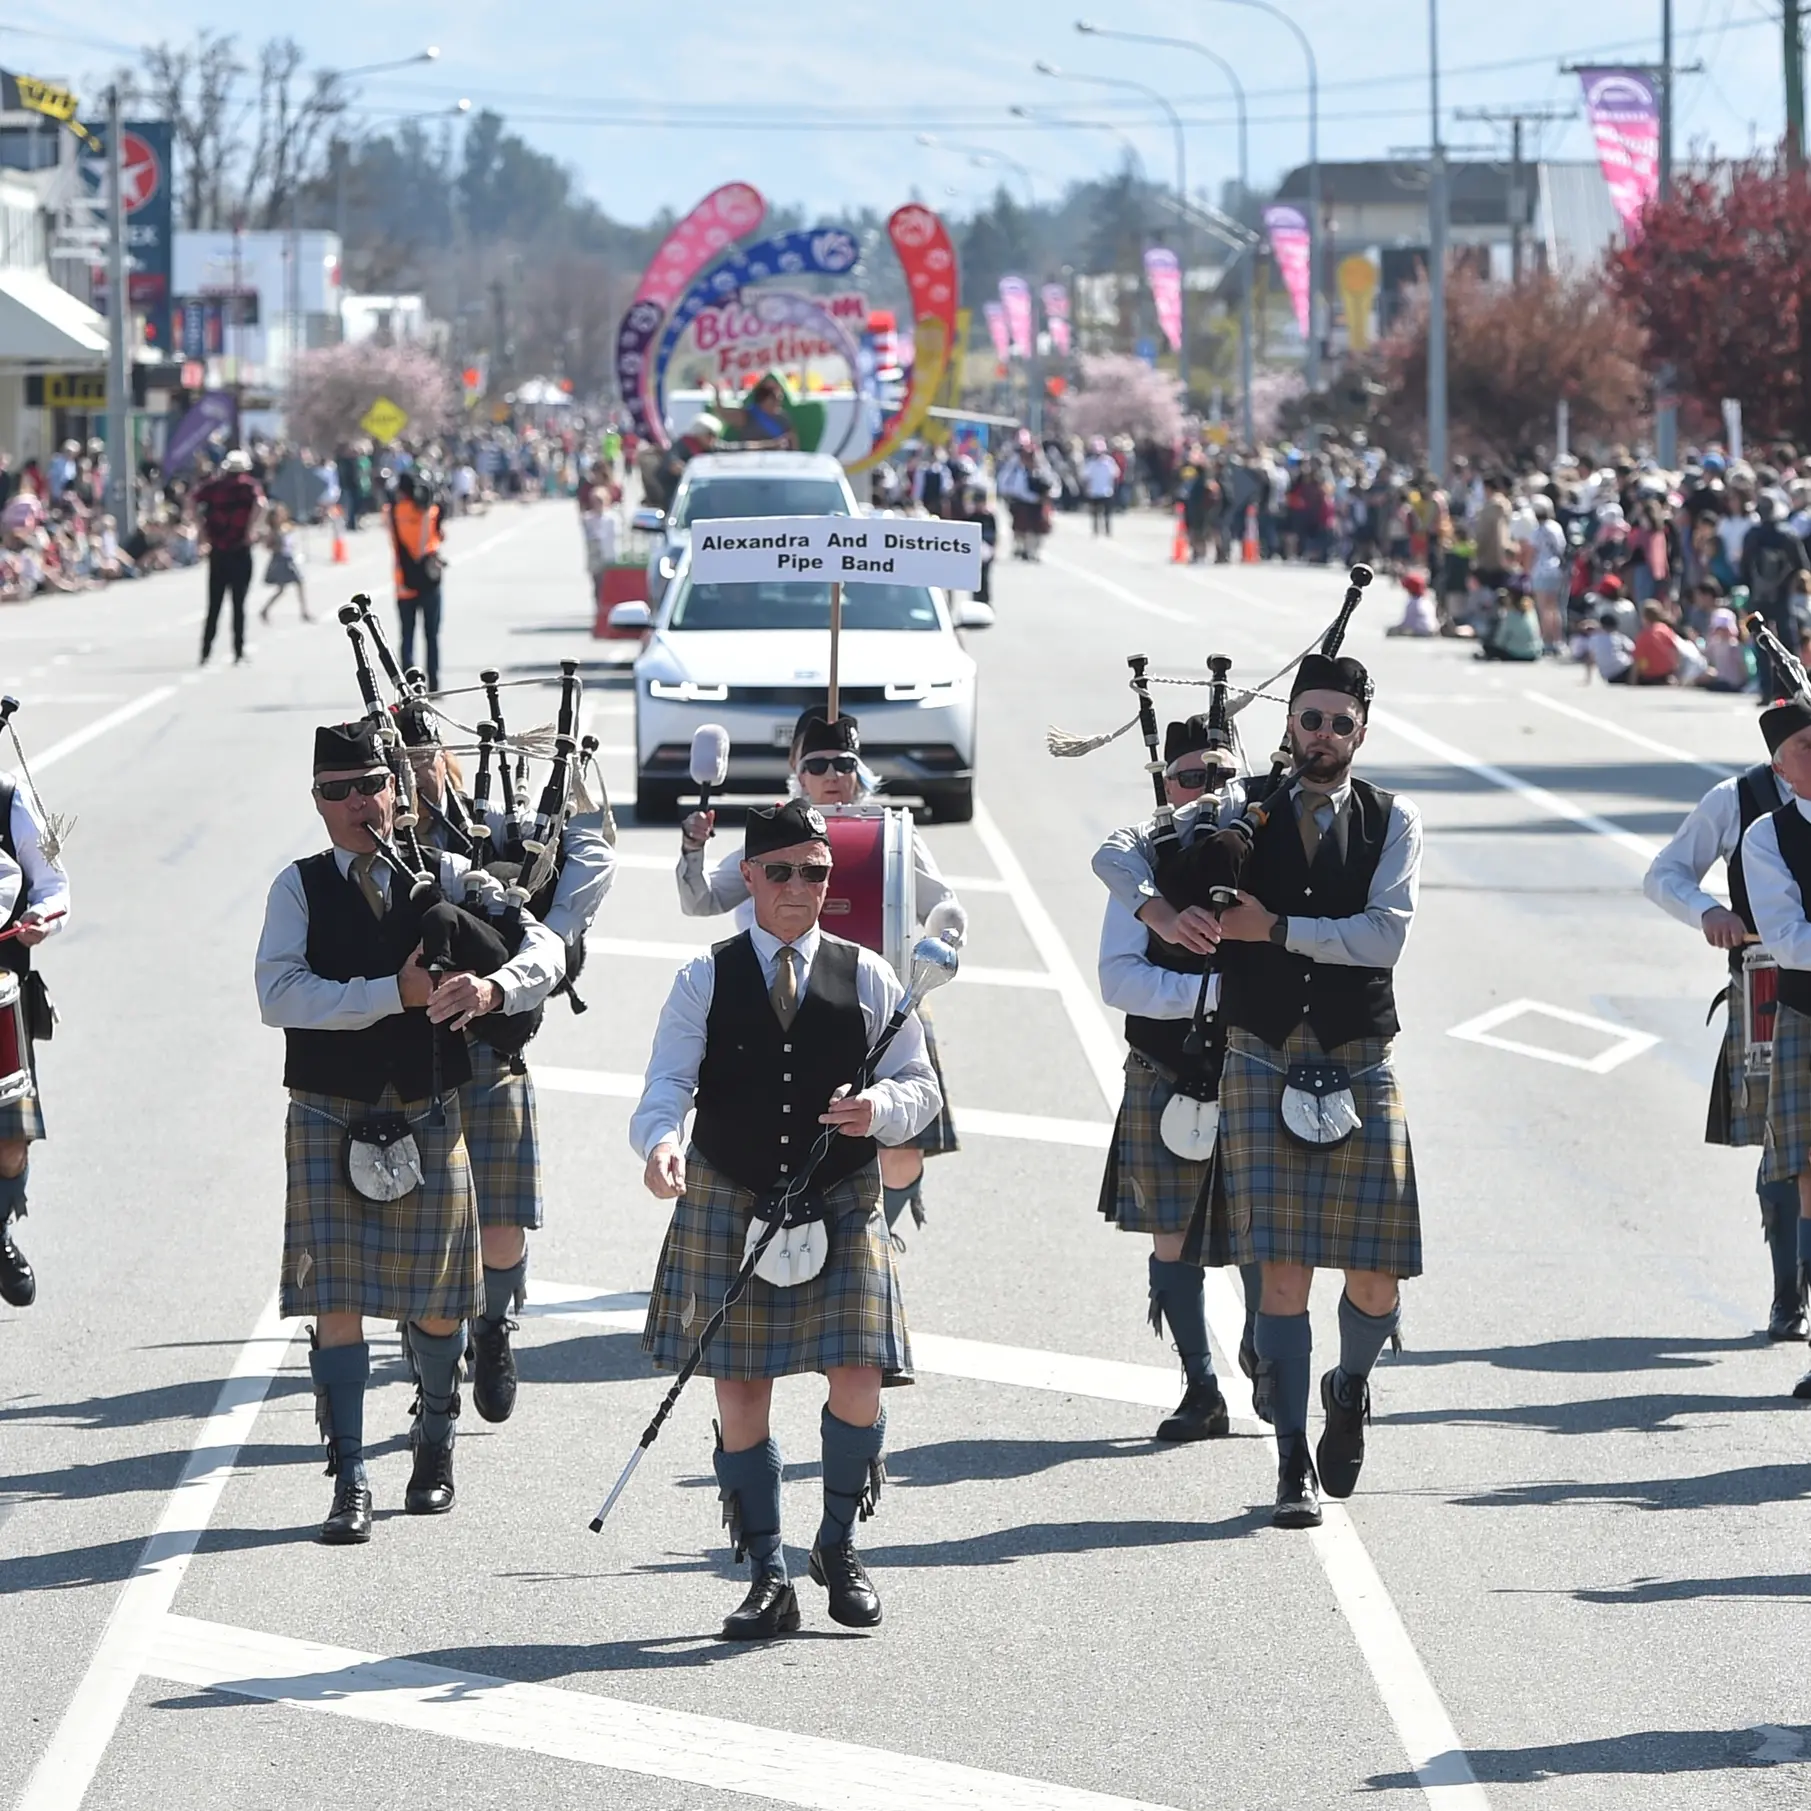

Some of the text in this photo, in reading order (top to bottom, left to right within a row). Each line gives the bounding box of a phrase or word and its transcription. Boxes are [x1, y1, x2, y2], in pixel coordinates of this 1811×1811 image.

[702, 532, 972, 554] Alexandra And Districts
[777, 553, 894, 573] Pipe Band
